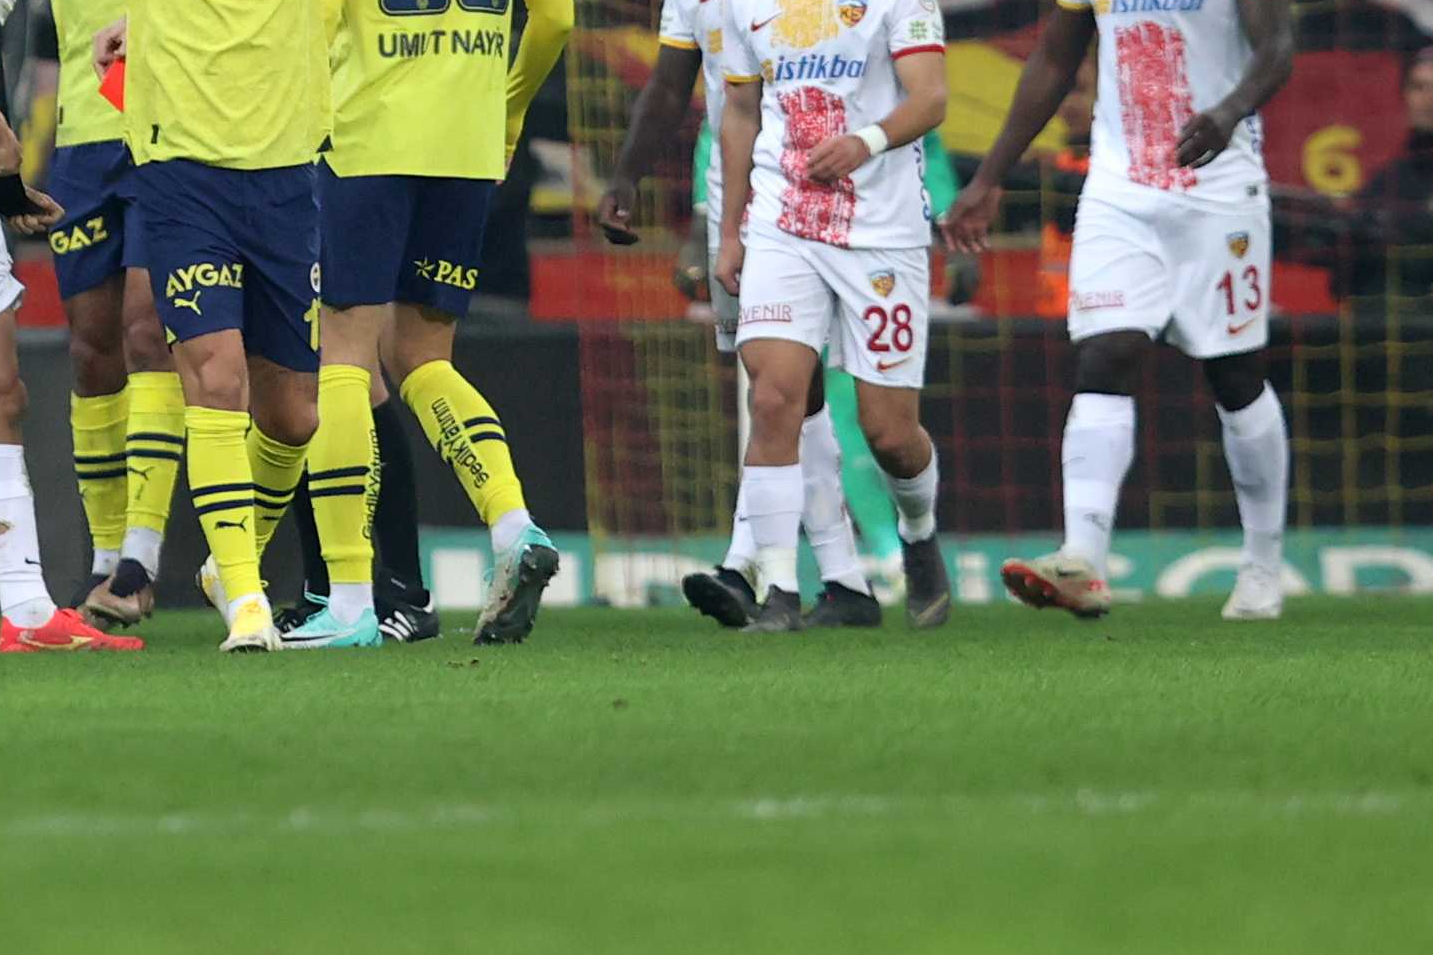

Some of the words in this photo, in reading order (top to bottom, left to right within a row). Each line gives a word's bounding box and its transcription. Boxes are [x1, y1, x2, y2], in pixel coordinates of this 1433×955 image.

[775, 54, 866, 81] istikba
[1303, 124, 1362, 197] 6
[167, 261, 245, 298] AYGAZ
[434, 260, 478, 289] PAS
[1216, 264, 1262, 315] 13
[304, 297, 322, 352] 1
[863, 303, 914, 353] 28
